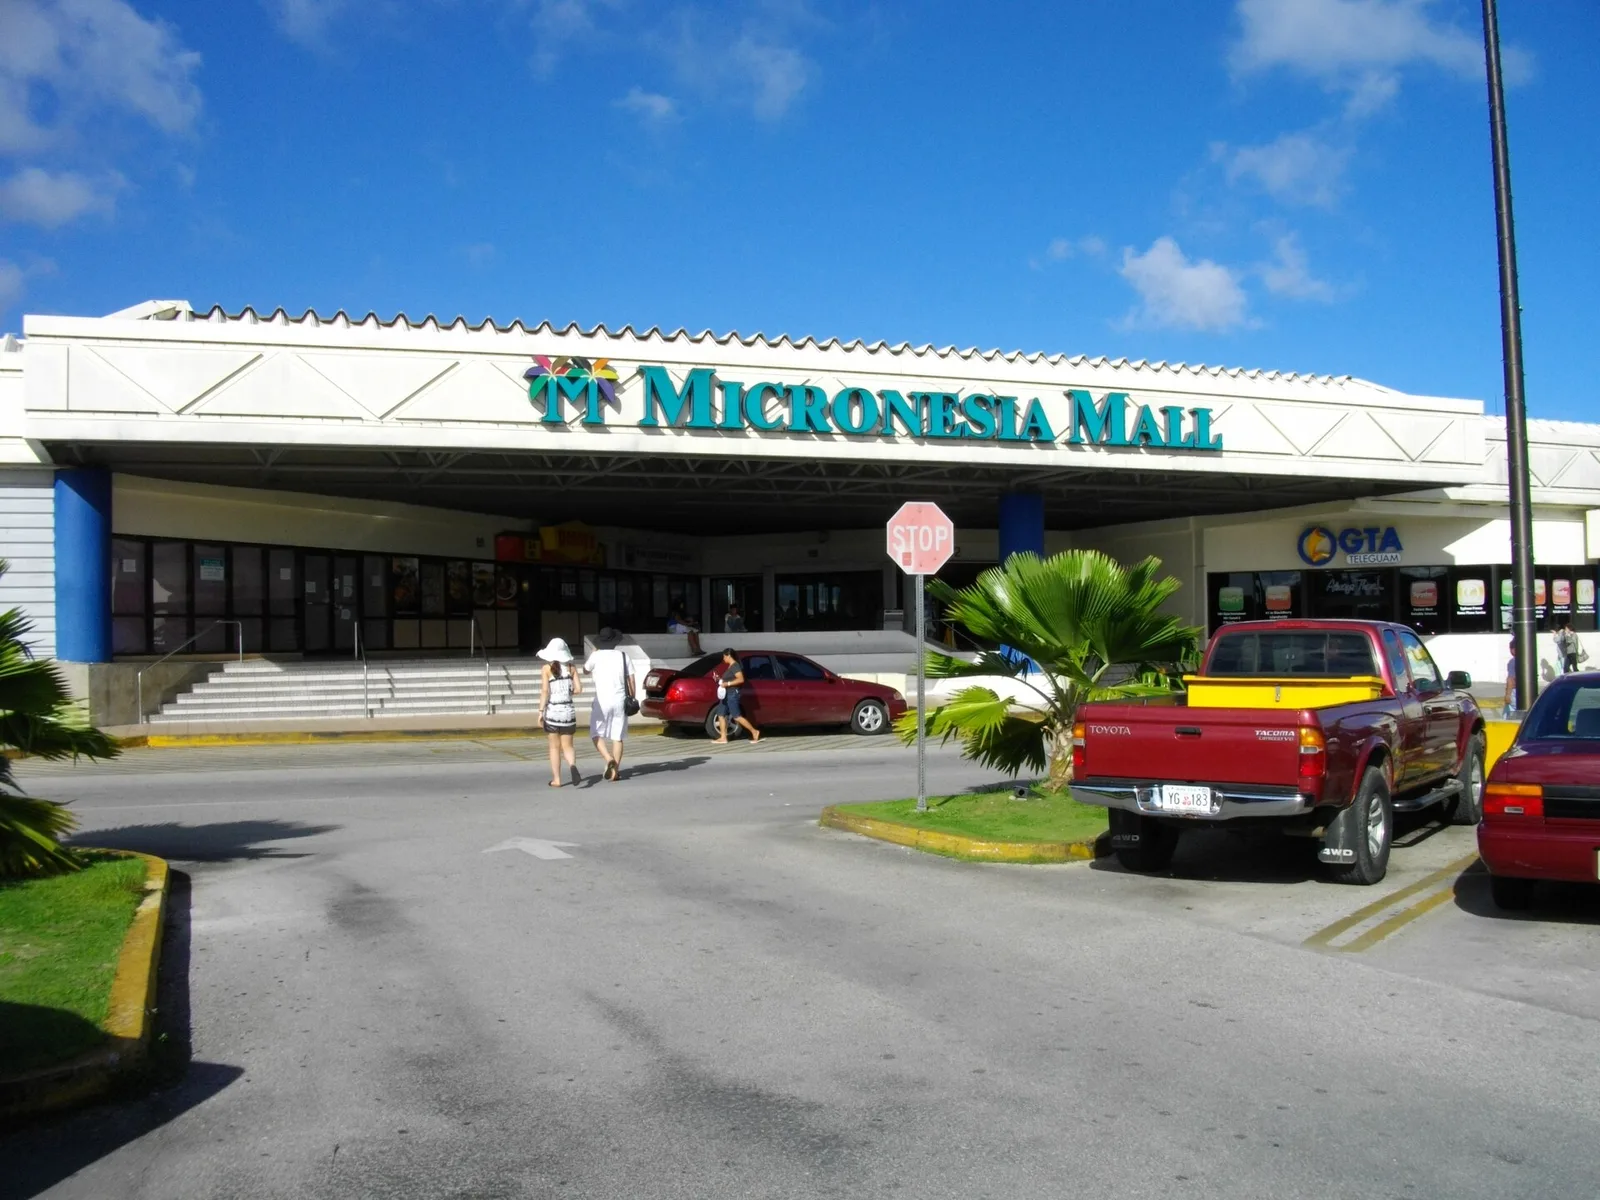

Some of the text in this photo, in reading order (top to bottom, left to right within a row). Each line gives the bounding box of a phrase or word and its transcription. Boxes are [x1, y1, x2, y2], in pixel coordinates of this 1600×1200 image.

[637, 365, 1055, 443] MICRONESIA
[1063, 389, 1223, 449] MALL
[892, 525, 948, 551] STOP
[1338, 527, 1404, 554] GTA
[1350, 554, 1399, 563] TELEGUAM
[1089, 725, 1131, 735] TOYOTA
[1168, 792, 1208, 806] YG 183
[1322, 847, 1353, 856] 4WD
